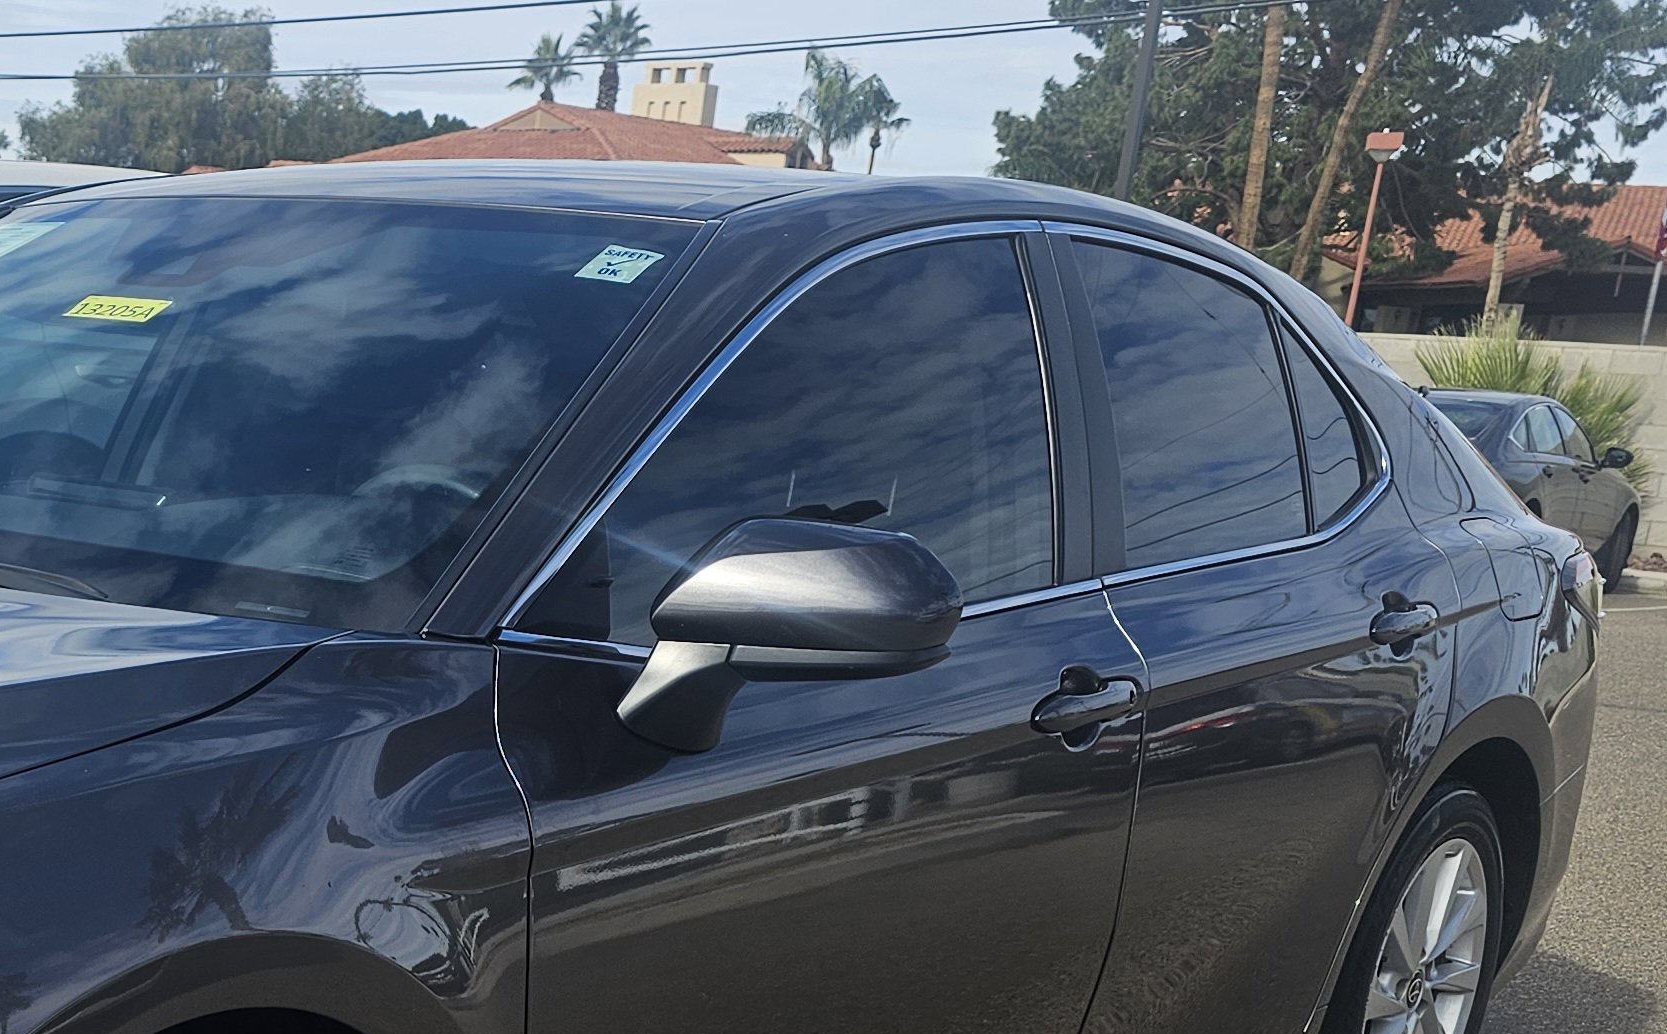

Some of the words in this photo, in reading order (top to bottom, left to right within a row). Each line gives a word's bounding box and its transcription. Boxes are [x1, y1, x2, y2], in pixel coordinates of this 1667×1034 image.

[604, 249, 654, 261] SAFETY
[597, 267, 622, 277] OK
[71, 302, 155, 319] 13205A
